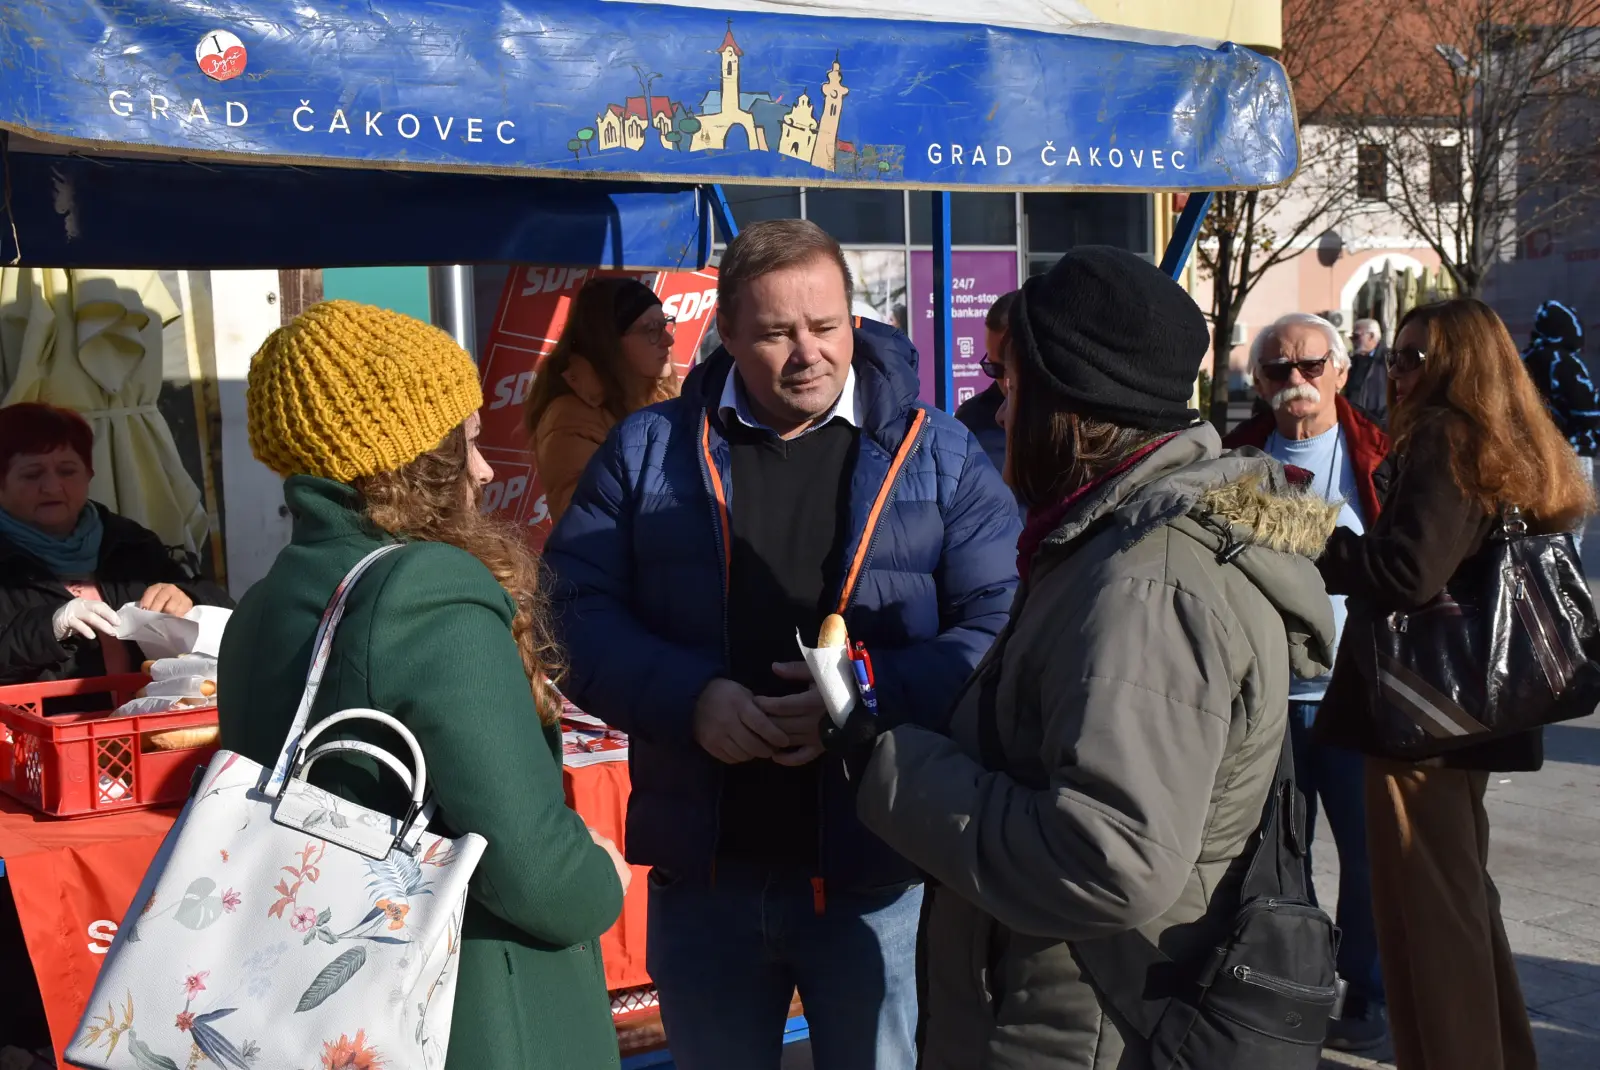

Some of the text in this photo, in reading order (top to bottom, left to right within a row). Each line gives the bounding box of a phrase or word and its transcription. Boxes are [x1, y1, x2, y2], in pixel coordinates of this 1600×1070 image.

[211, 34, 224, 54] I
[108, 90, 516, 145] GRAD ČAKOVEC
[927, 140, 1186, 170] GRAD ČAKOVEC
[952, 278, 975, 290] 24/7
[955, 292, 999, 304] non-stop
[661, 288, 718, 323] SDP
[951, 307, 988, 318] bankare
[489, 370, 537, 410] SD
[480, 475, 528, 515] DP
